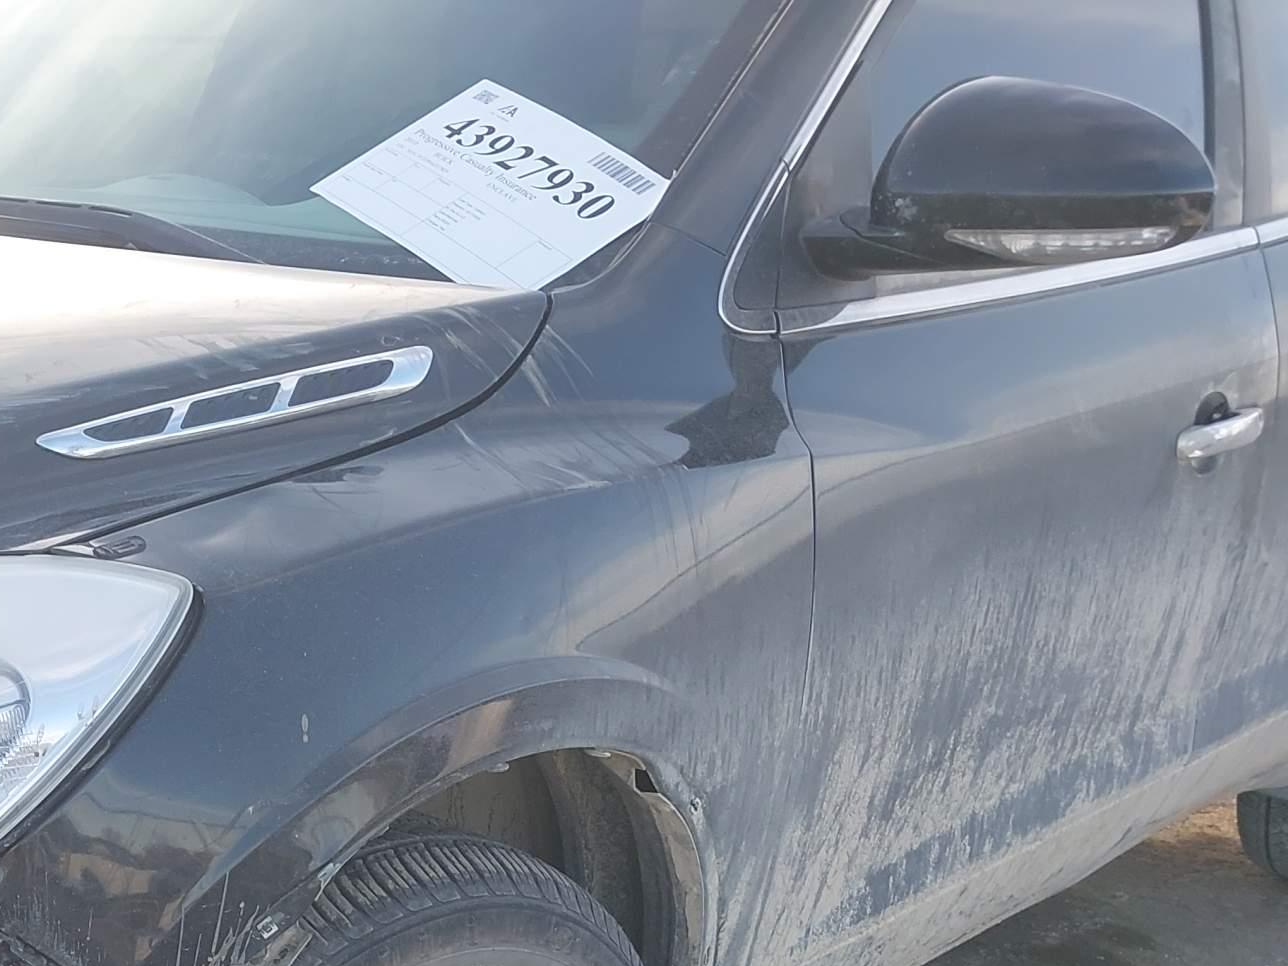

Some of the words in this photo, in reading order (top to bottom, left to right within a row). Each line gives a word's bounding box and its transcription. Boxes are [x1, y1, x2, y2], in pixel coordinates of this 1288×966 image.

[414, 128, 461, 156] Progressive
[459, 152, 494, 177] Casualty
[495, 172, 537, 201] Insurance
[443, 118, 616, 219] 43927930
